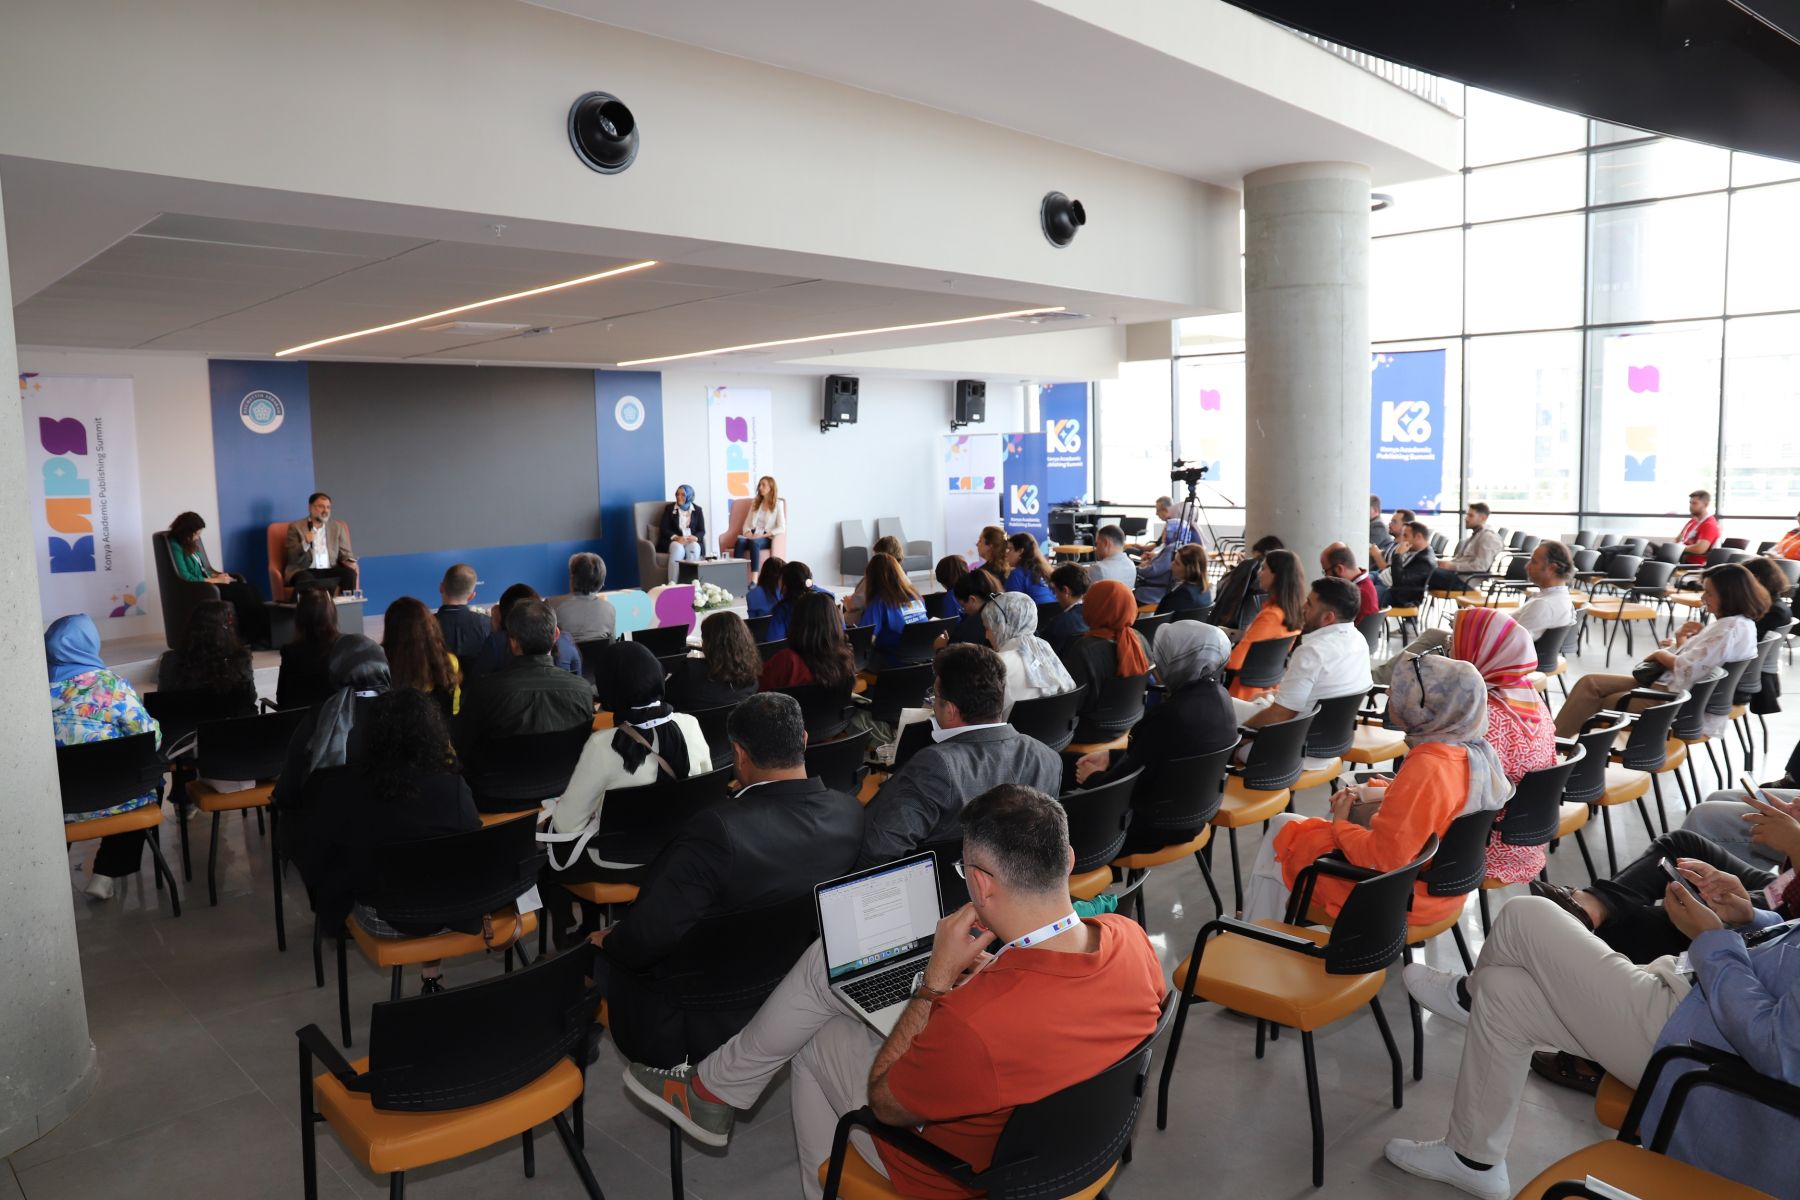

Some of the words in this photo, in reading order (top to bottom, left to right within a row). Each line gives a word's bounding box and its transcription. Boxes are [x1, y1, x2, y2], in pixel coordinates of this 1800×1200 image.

[95, 417, 104, 452] Summit
[96, 453, 106, 498] Publishing
[949, 476, 995, 490] KAPS
[99, 499, 109, 542] Academic
[104, 543, 112, 571] Konya
